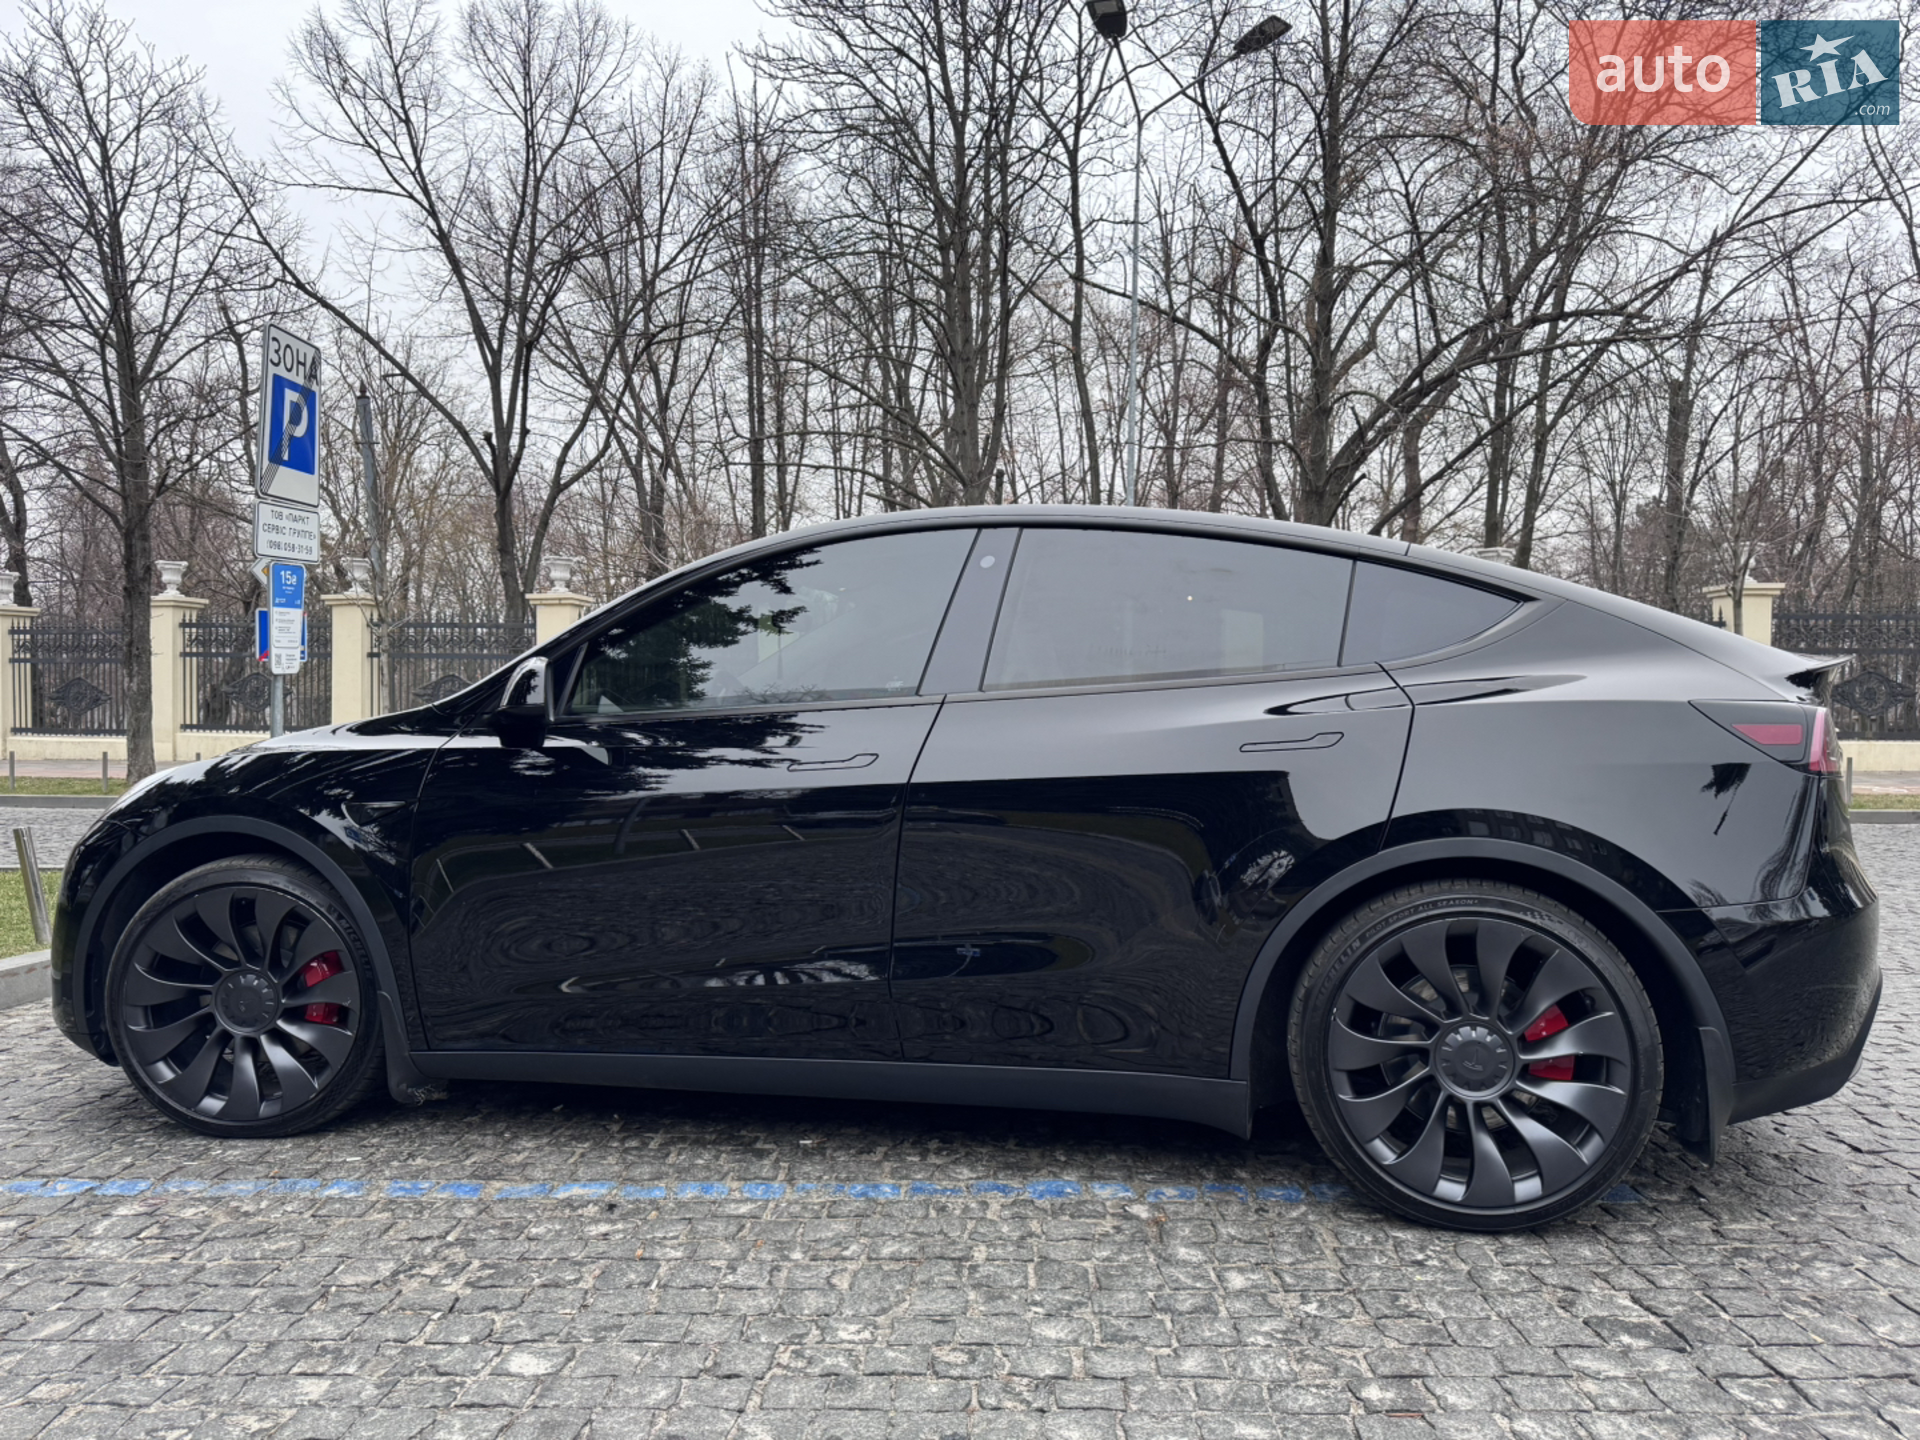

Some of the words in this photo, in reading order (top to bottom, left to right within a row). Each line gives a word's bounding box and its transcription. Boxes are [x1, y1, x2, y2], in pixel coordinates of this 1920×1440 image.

[270, 337, 319, 386] ЗОНА
[281, 387, 309, 461] P
[262, 522, 287, 536] СЕРВІС
[271, 509, 283, 520] ТОВ
[1365, 921, 1387, 938] PILOT
[1388, 908, 1415, 923] SPORT
[1418, 902, 1434, 912] ALL
